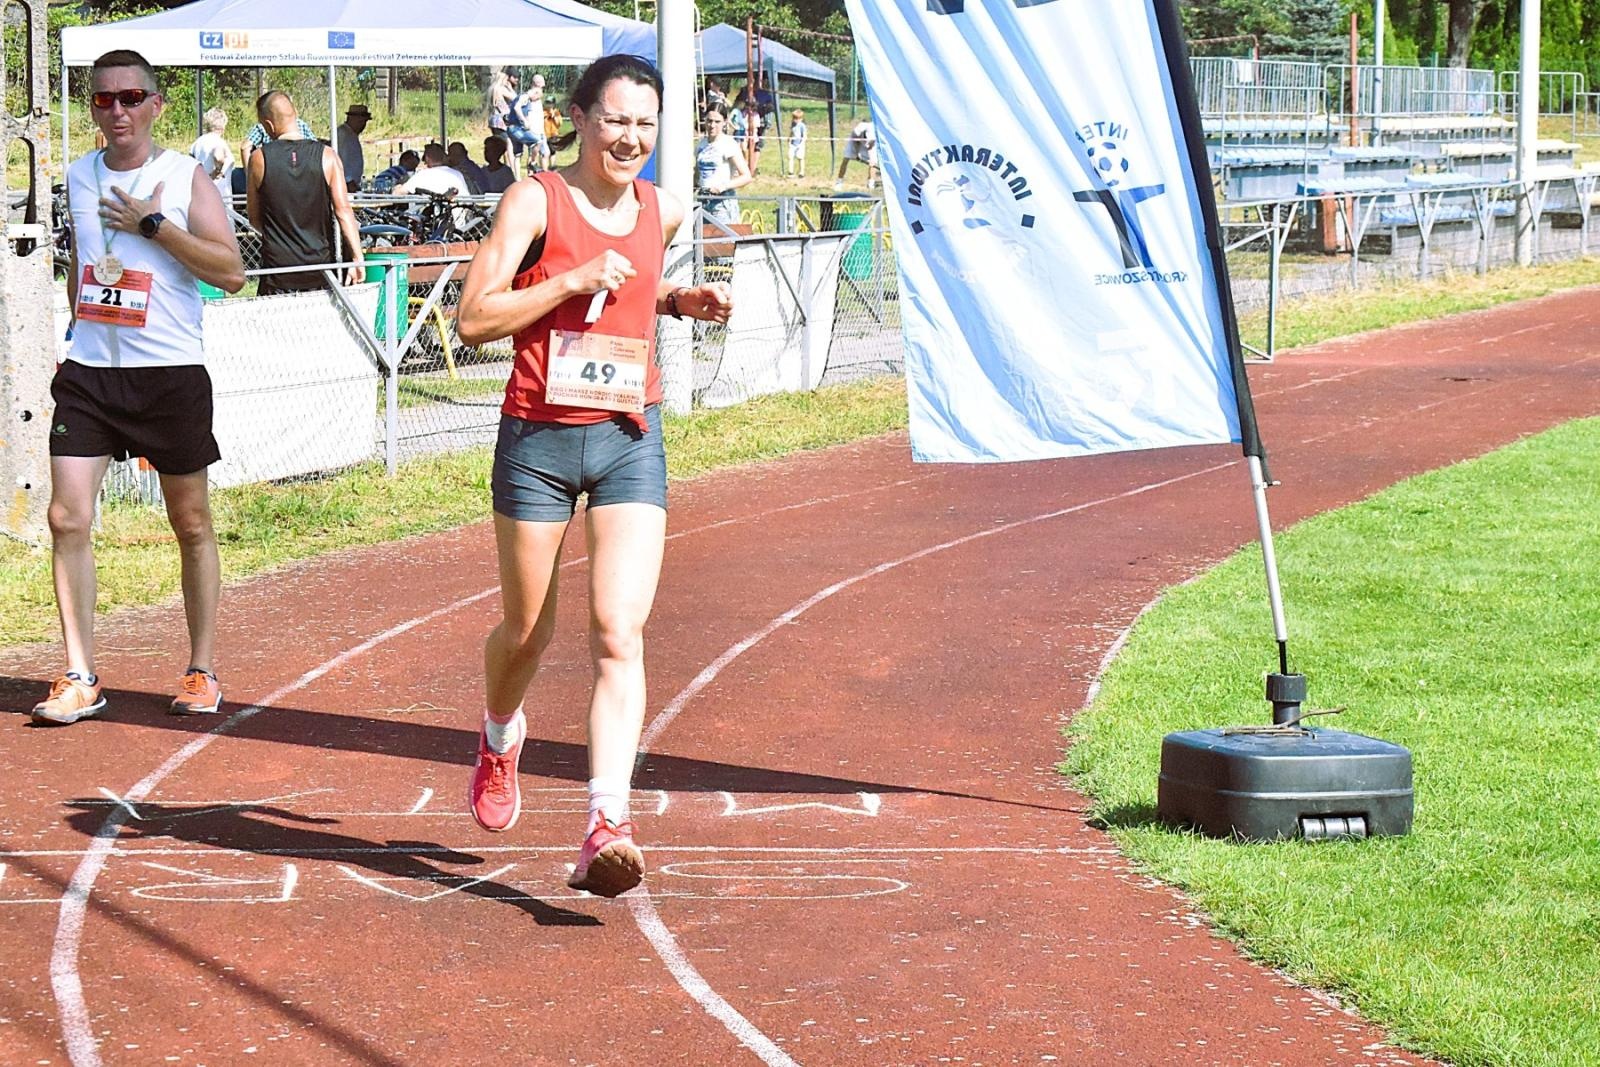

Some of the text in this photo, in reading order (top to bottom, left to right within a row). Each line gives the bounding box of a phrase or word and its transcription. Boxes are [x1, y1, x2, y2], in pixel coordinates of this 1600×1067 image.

[202, 33, 221, 46] CZ
[100, 288, 122, 306] 21
[580, 361, 617, 385] 49
